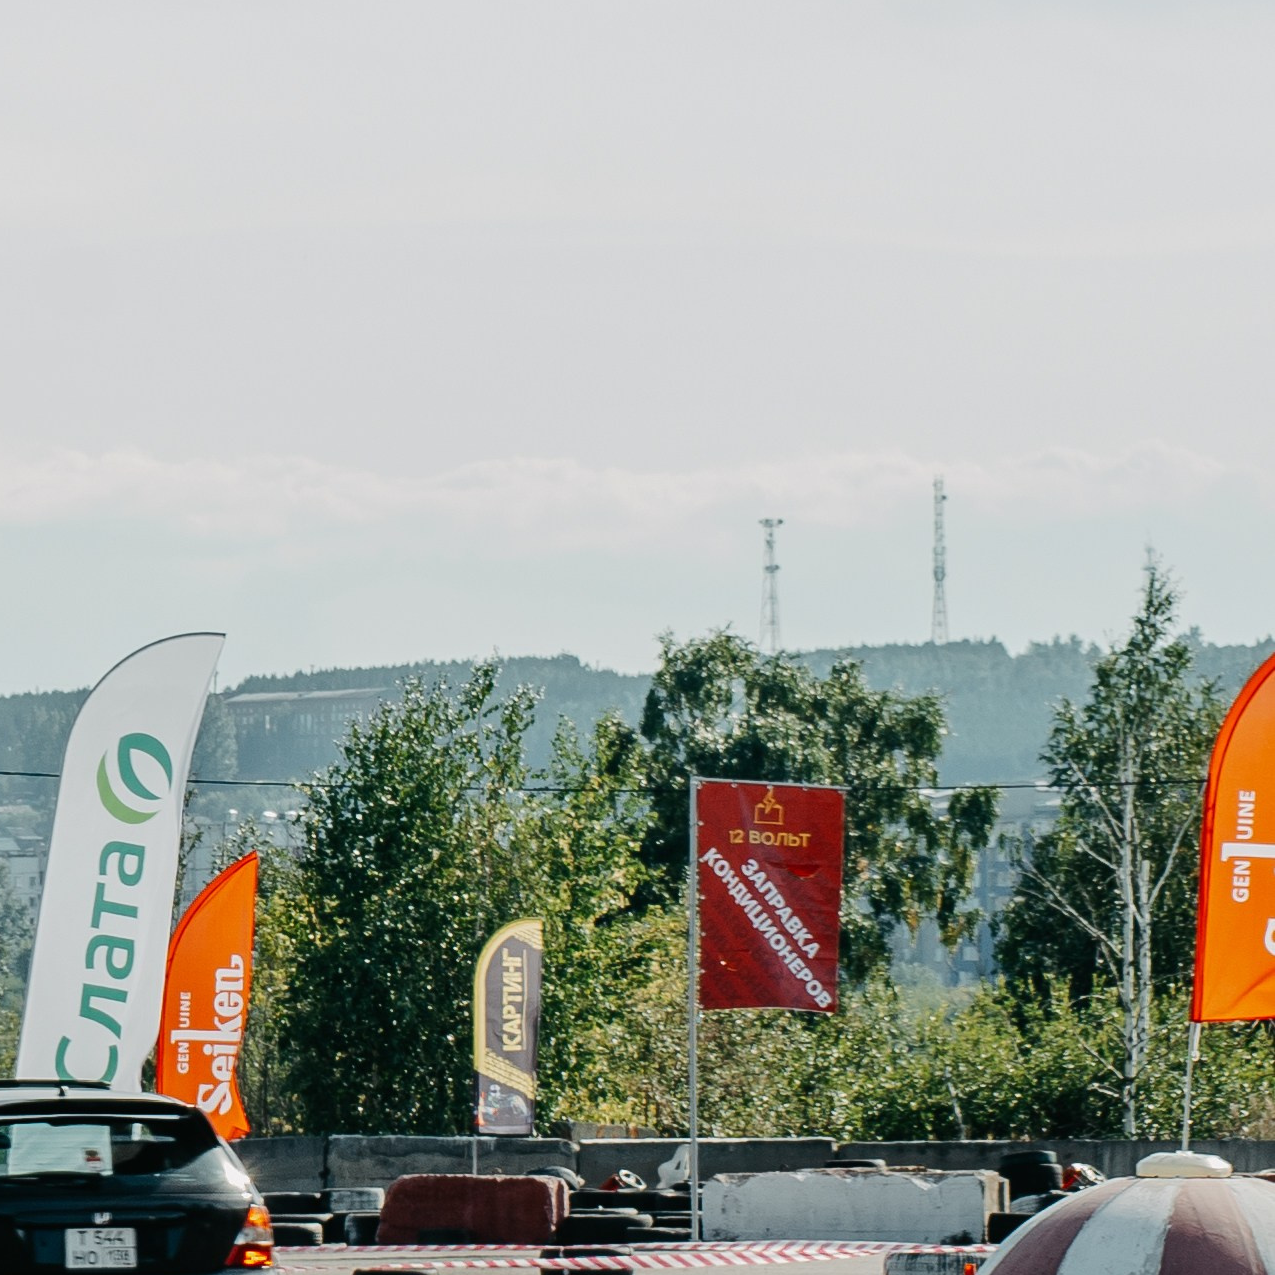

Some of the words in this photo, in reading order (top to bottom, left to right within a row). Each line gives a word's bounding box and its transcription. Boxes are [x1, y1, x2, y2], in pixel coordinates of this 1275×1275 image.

[729, 830, 744, 844] 12
[749, 830, 811, 847] ВОЛЬТ
[55, 841, 146, 1081] Слата
[699, 847, 832, 1009] КОНДИЦИОНЕРОВ
[741, 858, 820, 959] ЗАПРАВКА
[171, 954, 244, 1115] Seiken
[502, 947, 523, 1052] КАРТИНГ
